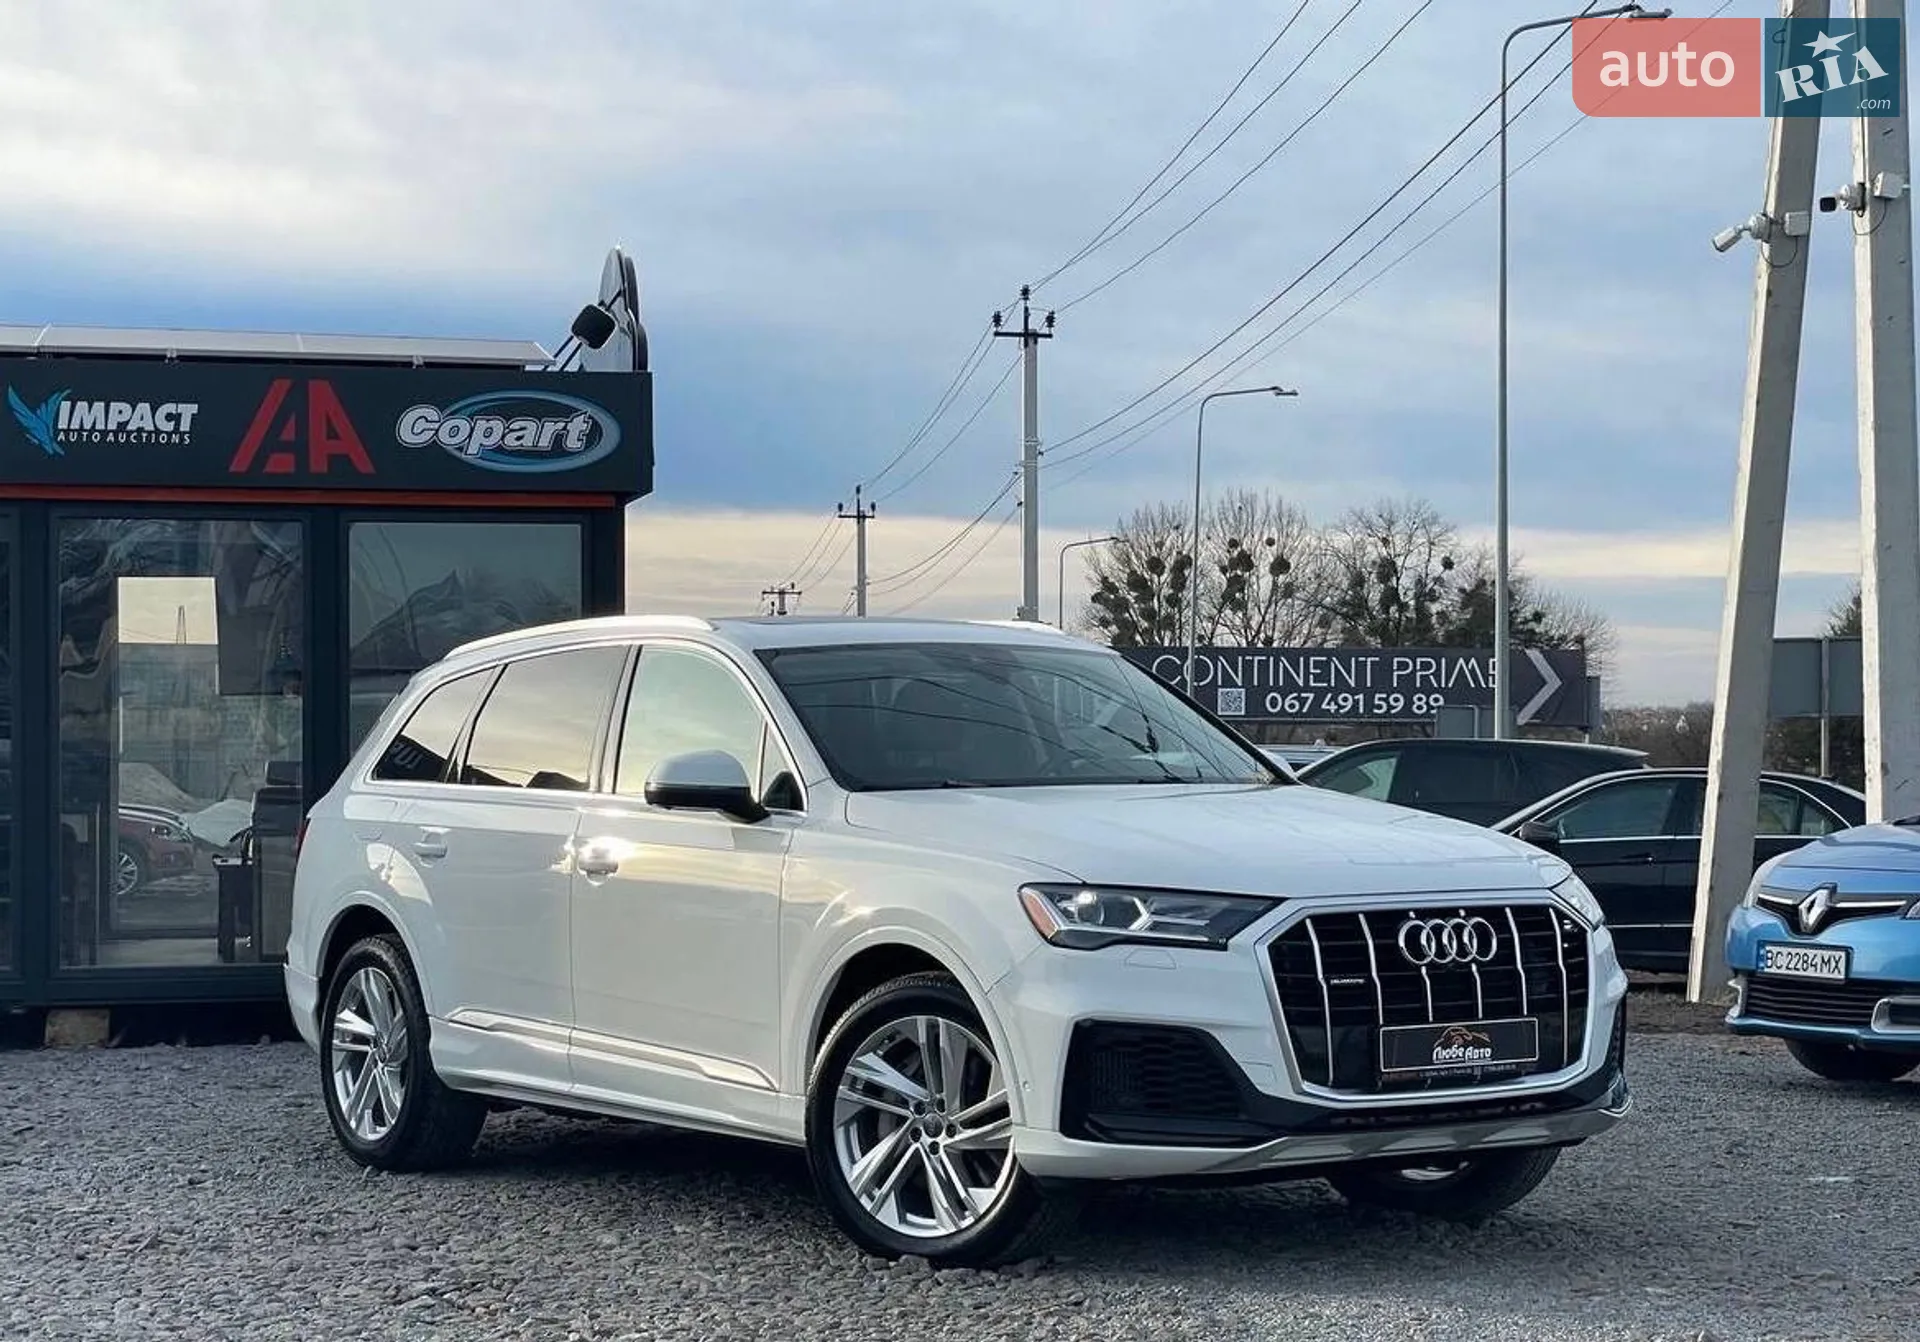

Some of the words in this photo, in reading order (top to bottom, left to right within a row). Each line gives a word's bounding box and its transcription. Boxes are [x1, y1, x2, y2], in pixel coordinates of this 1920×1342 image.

[57, 401, 199, 432] IMPACT
[396, 404, 592, 458] Copart
[57, 431, 101, 443] AUTO
[106, 432, 191, 445] AUCTIONS
[1152, 655, 1380, 687] CONTINENT
[1265, 693, 1315, 713] 067
[1321, 693, 1364, 714] 491
[1373, 693, 1404, 714] 59
[1412, 693, 1445, 714] 89
